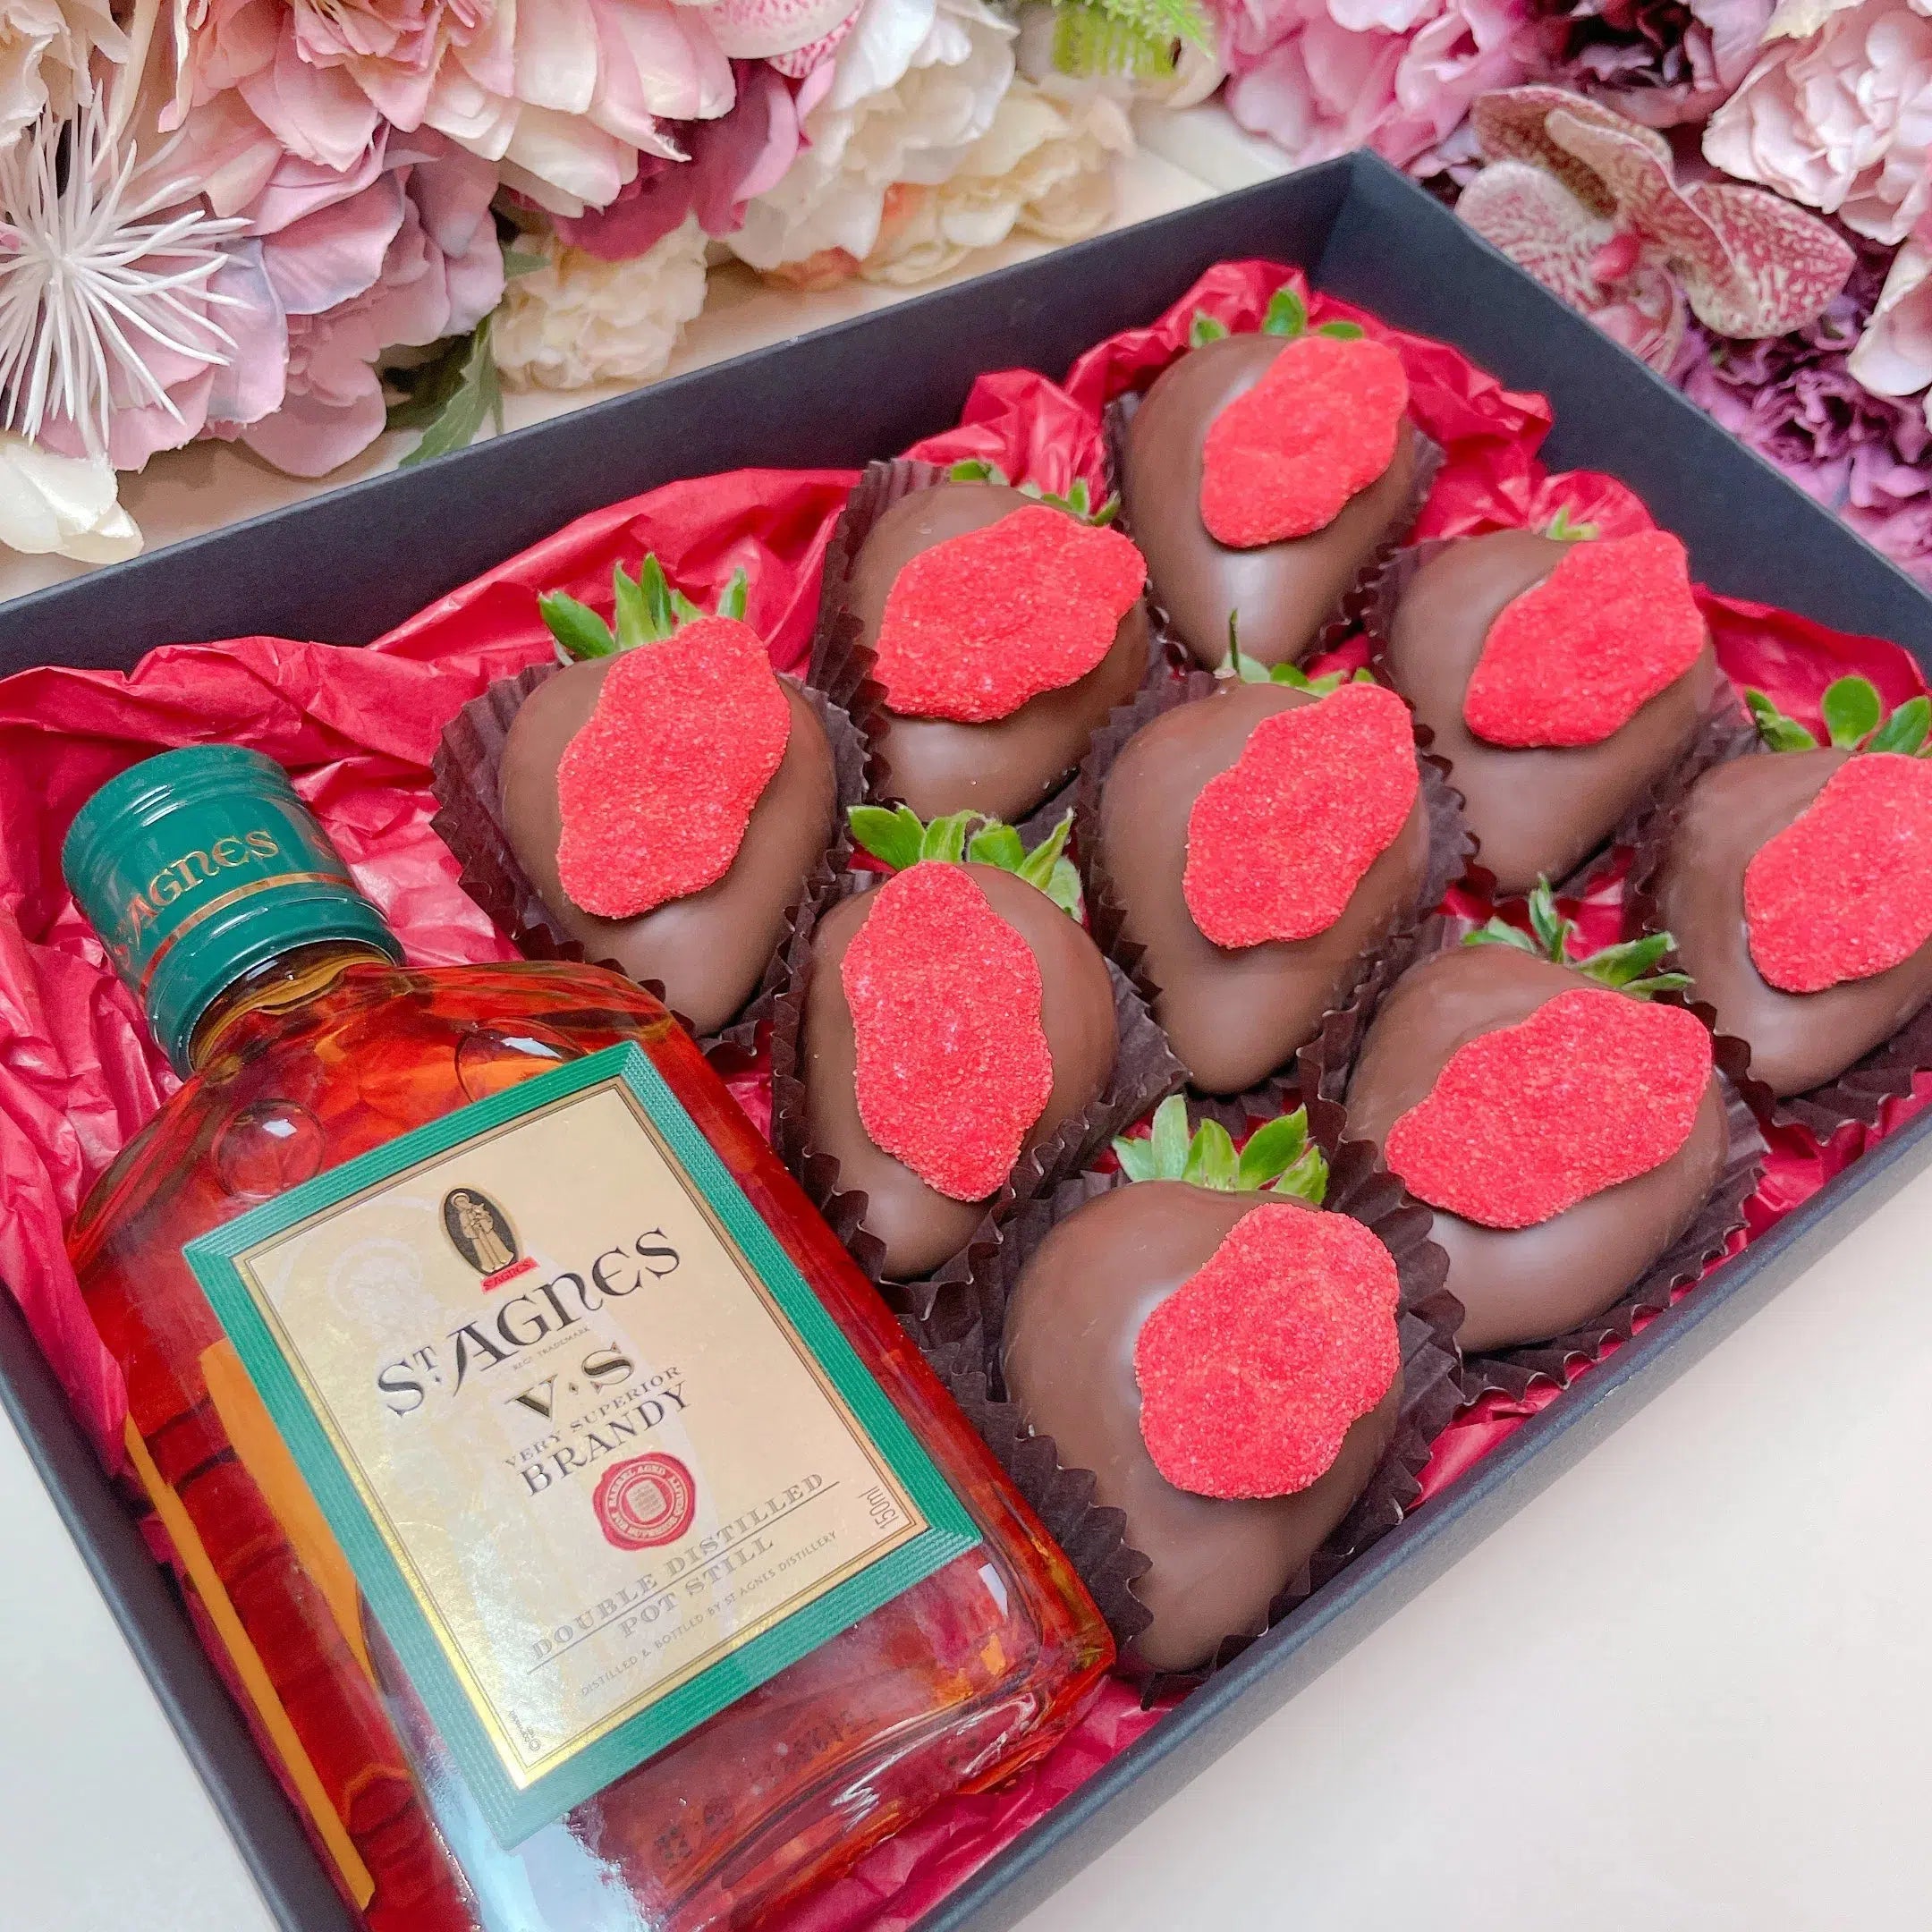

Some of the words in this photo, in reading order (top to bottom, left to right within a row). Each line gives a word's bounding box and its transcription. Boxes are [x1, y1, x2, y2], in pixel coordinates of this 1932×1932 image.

[127, 830, 279, 951] AGNES
[446, 1226, 681, 1397] AGNES
[538, 1326, 590, 1357] TRADEMARK
[504, 1431, 563, 1468] VERY
[570, 1366, 682, 1433] SUPERIOR
[519, 1380, 691, 1496] BRANDY
[856, 1485, 900, 1529] 150ml
[531, 1572, 658, 1662] DOUBLE
[664, 1472, 825, 1576] DISTILLED
[581, 1655, 639, 1697] DISTILLED
[641, 1649, 651, 1658] &
[654, 1615, 704, 1649] BOTTLED
[708, 1604, 722, 1615] BY
[740, 1570, 776, 1597] AGNES
[777, 1530, 837, 1572] DISTILLERY
[618, 1591, 677, 1638] POT
[686, 1537, 775, 1596] STILL
